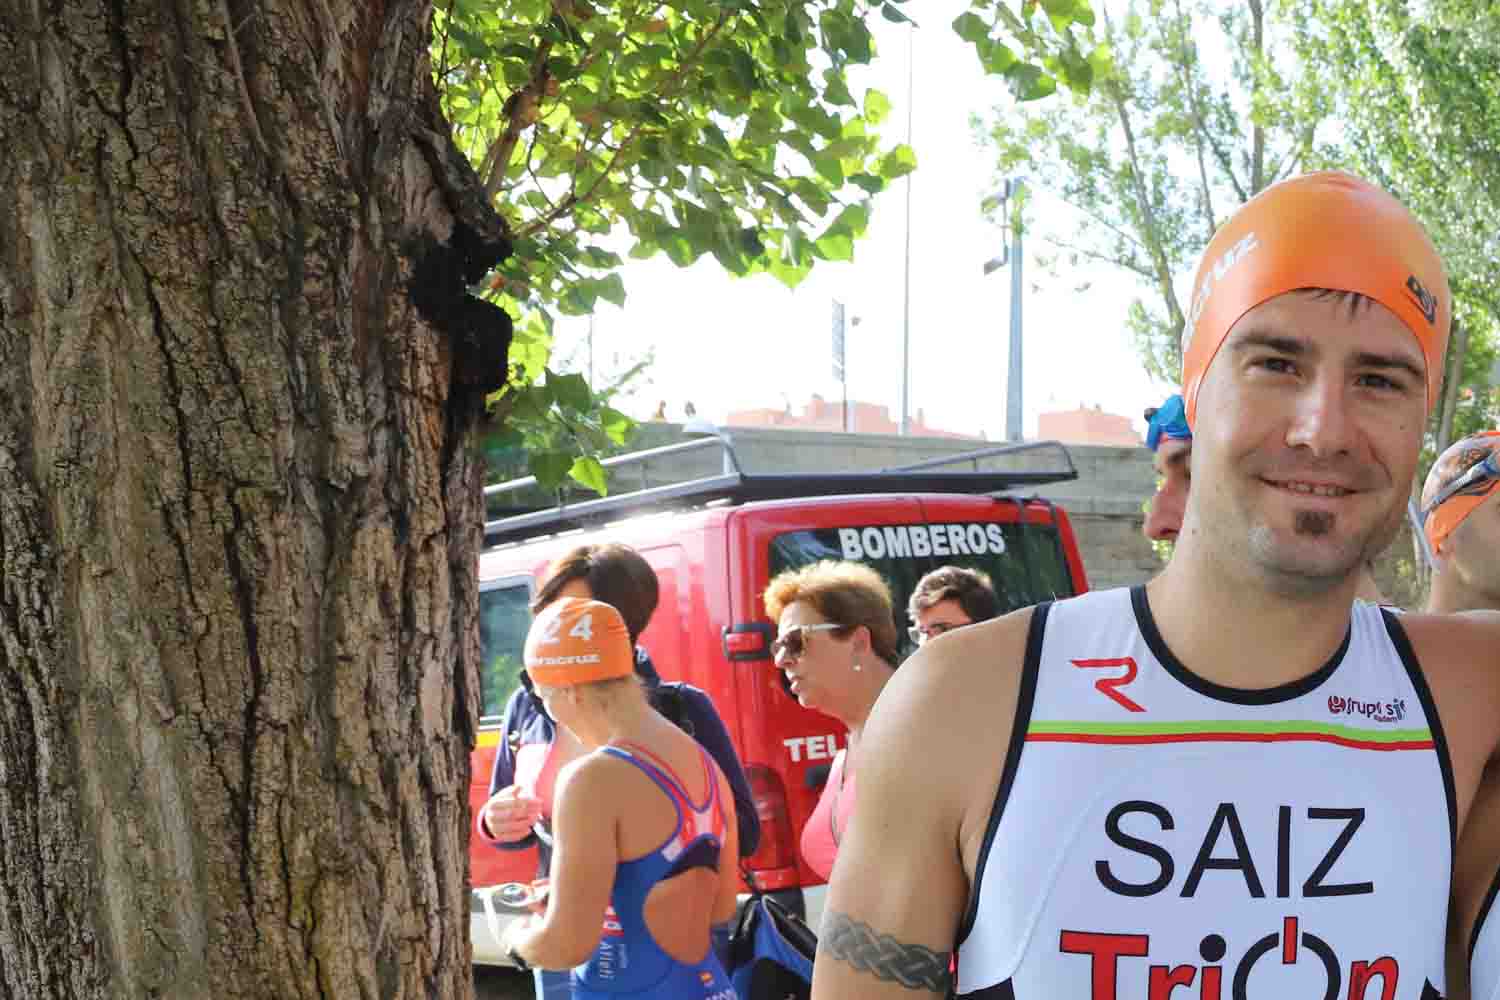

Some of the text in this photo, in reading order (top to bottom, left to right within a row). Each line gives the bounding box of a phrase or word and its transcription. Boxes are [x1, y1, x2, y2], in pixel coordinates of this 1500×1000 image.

[838, 523, 1006, 561] BOMBEROS
[784, 735, 854, 762] TEL
[1094, 799, 1375, 900] SAIZ
